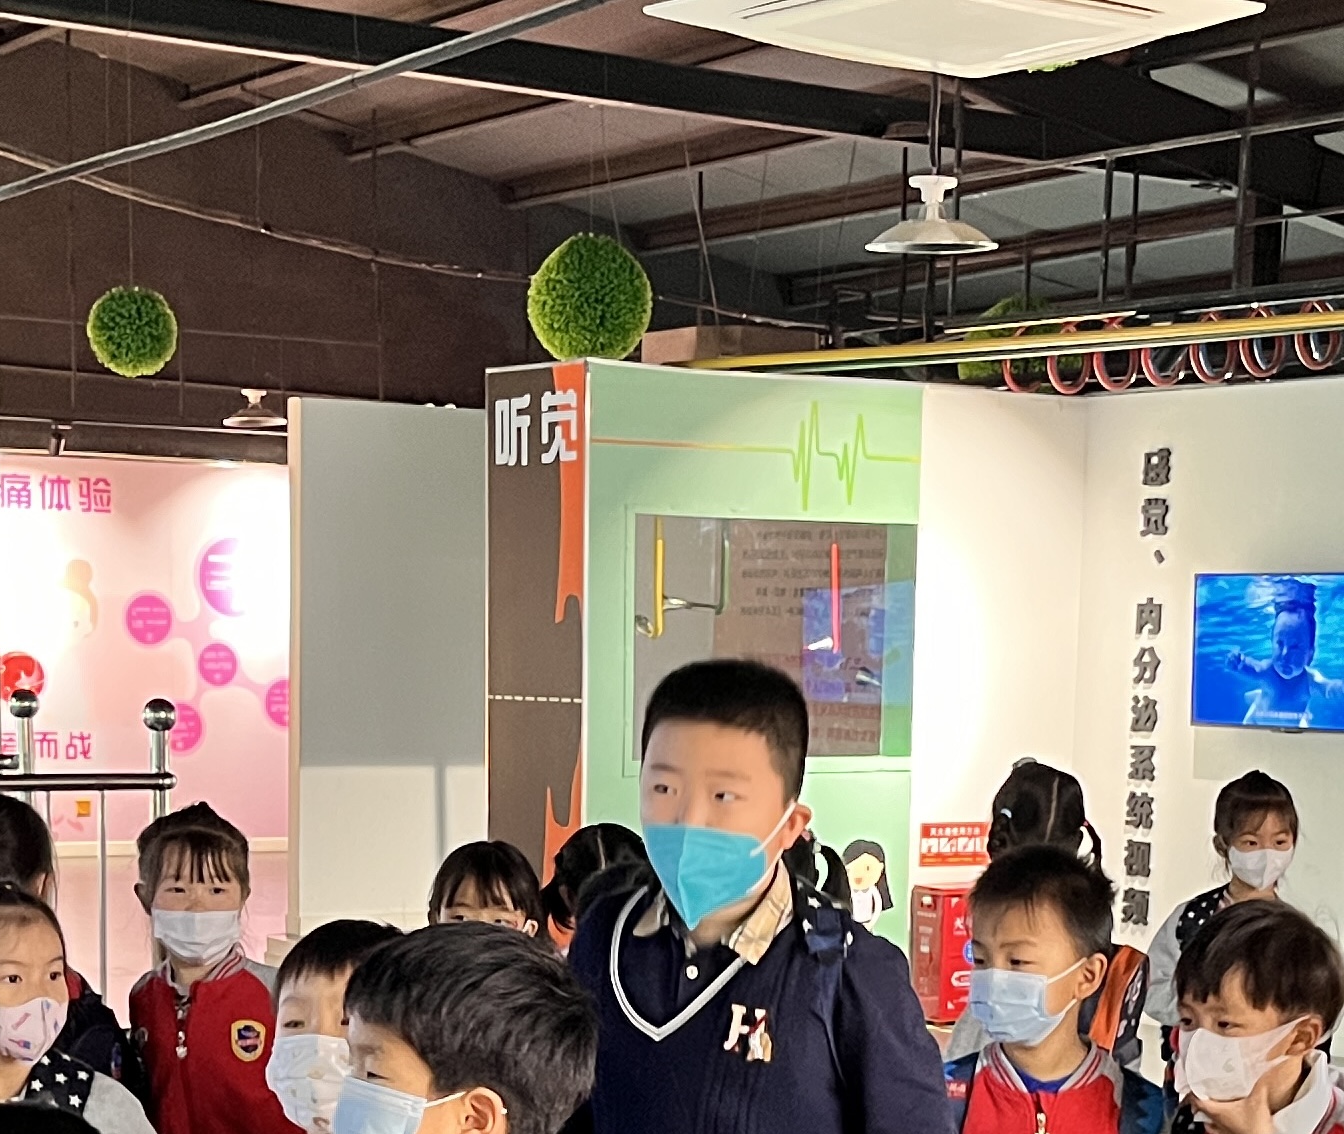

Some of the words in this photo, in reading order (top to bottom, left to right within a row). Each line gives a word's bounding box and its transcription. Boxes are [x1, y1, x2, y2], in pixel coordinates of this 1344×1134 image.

[494, 390, 578, 466] 听觉
[0, 473, 113, 513] 痛体验
